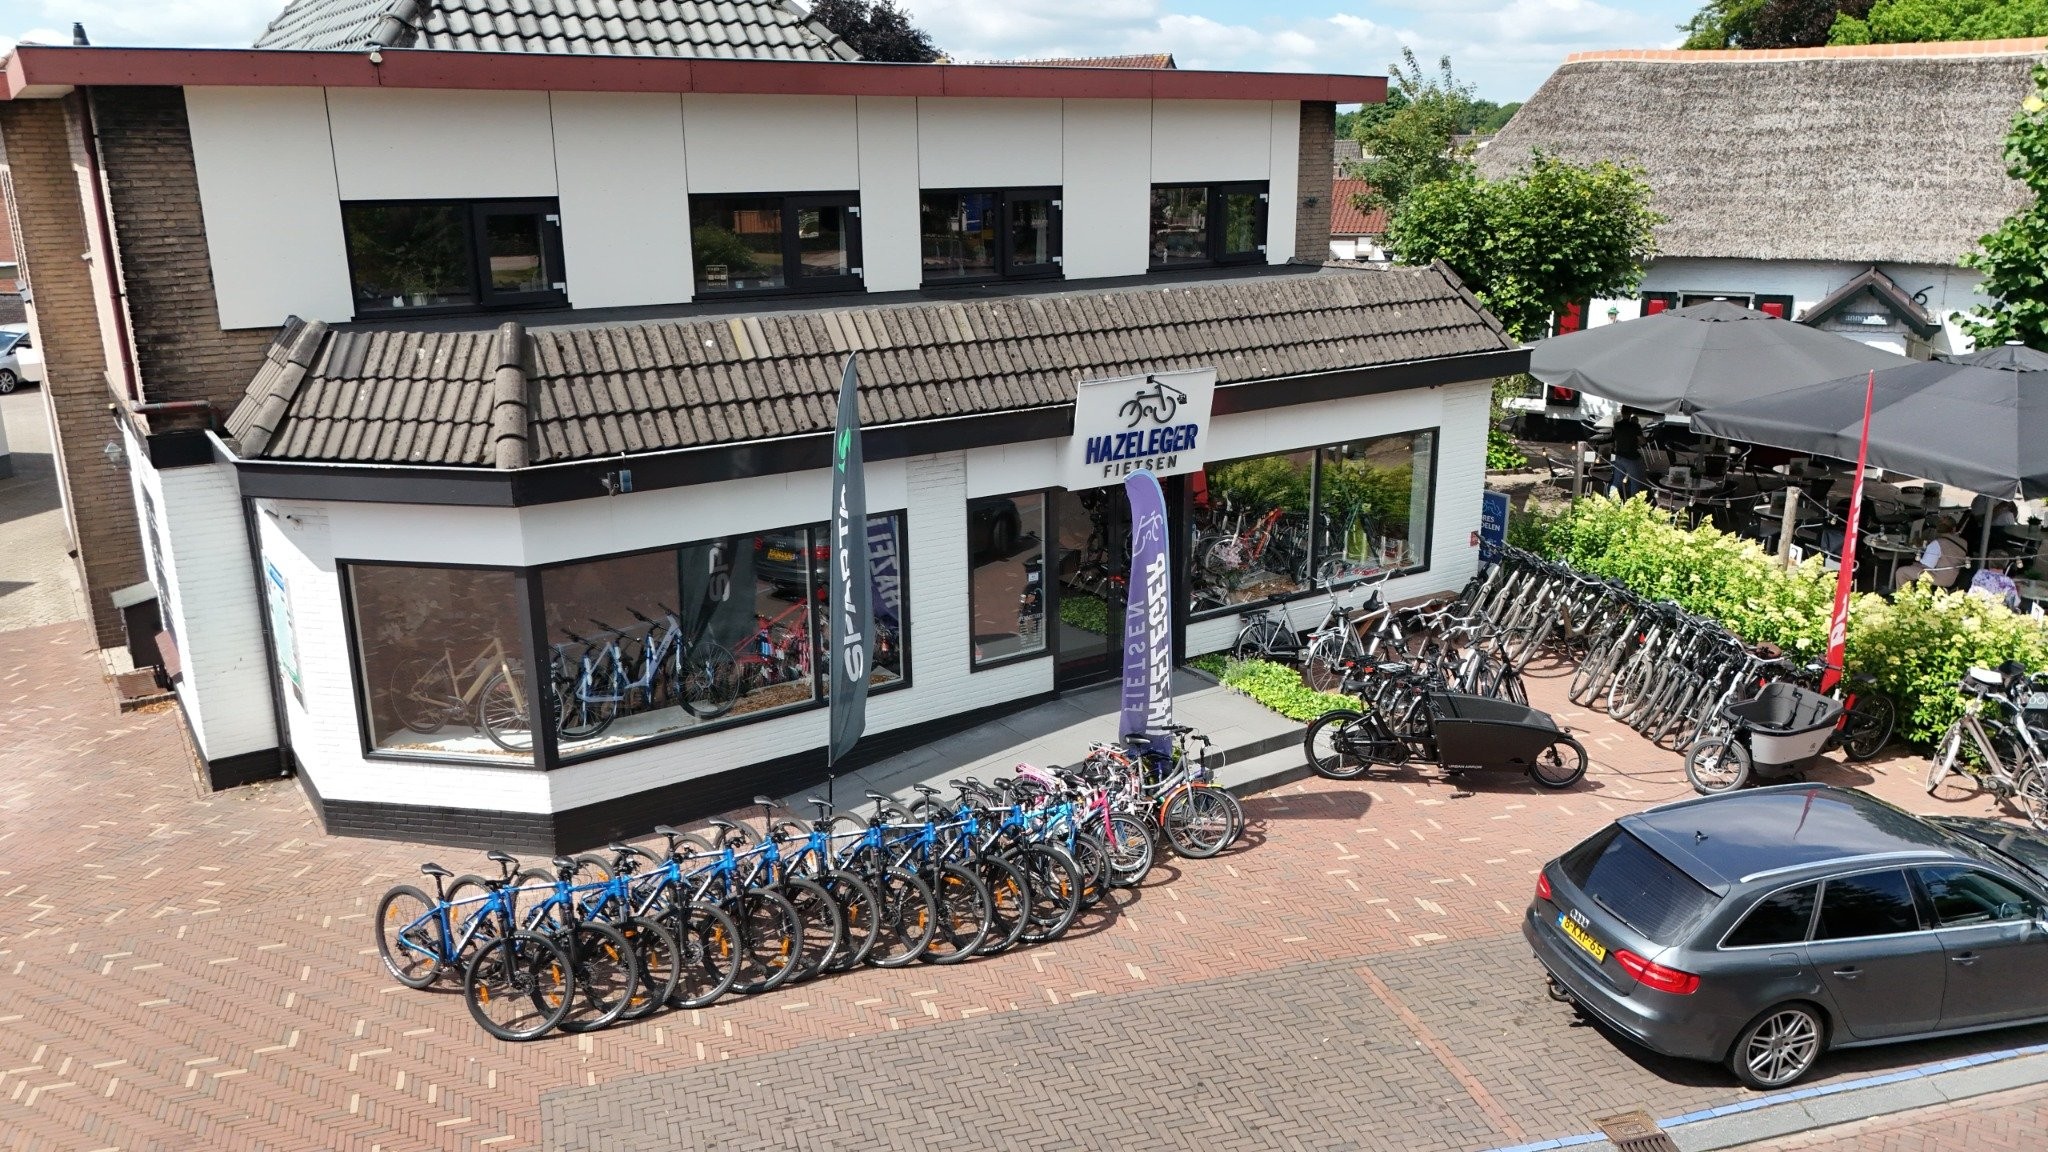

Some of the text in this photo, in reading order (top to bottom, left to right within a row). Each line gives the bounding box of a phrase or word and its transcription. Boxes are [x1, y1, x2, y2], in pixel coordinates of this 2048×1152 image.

[1912, 285, 1934, 306] 6
[1085, 423, 1199, 465] HAZELEGER
[1103, 454, 1178, 478] FIETSEN
[838, 483, 864, 682] SPARTA
